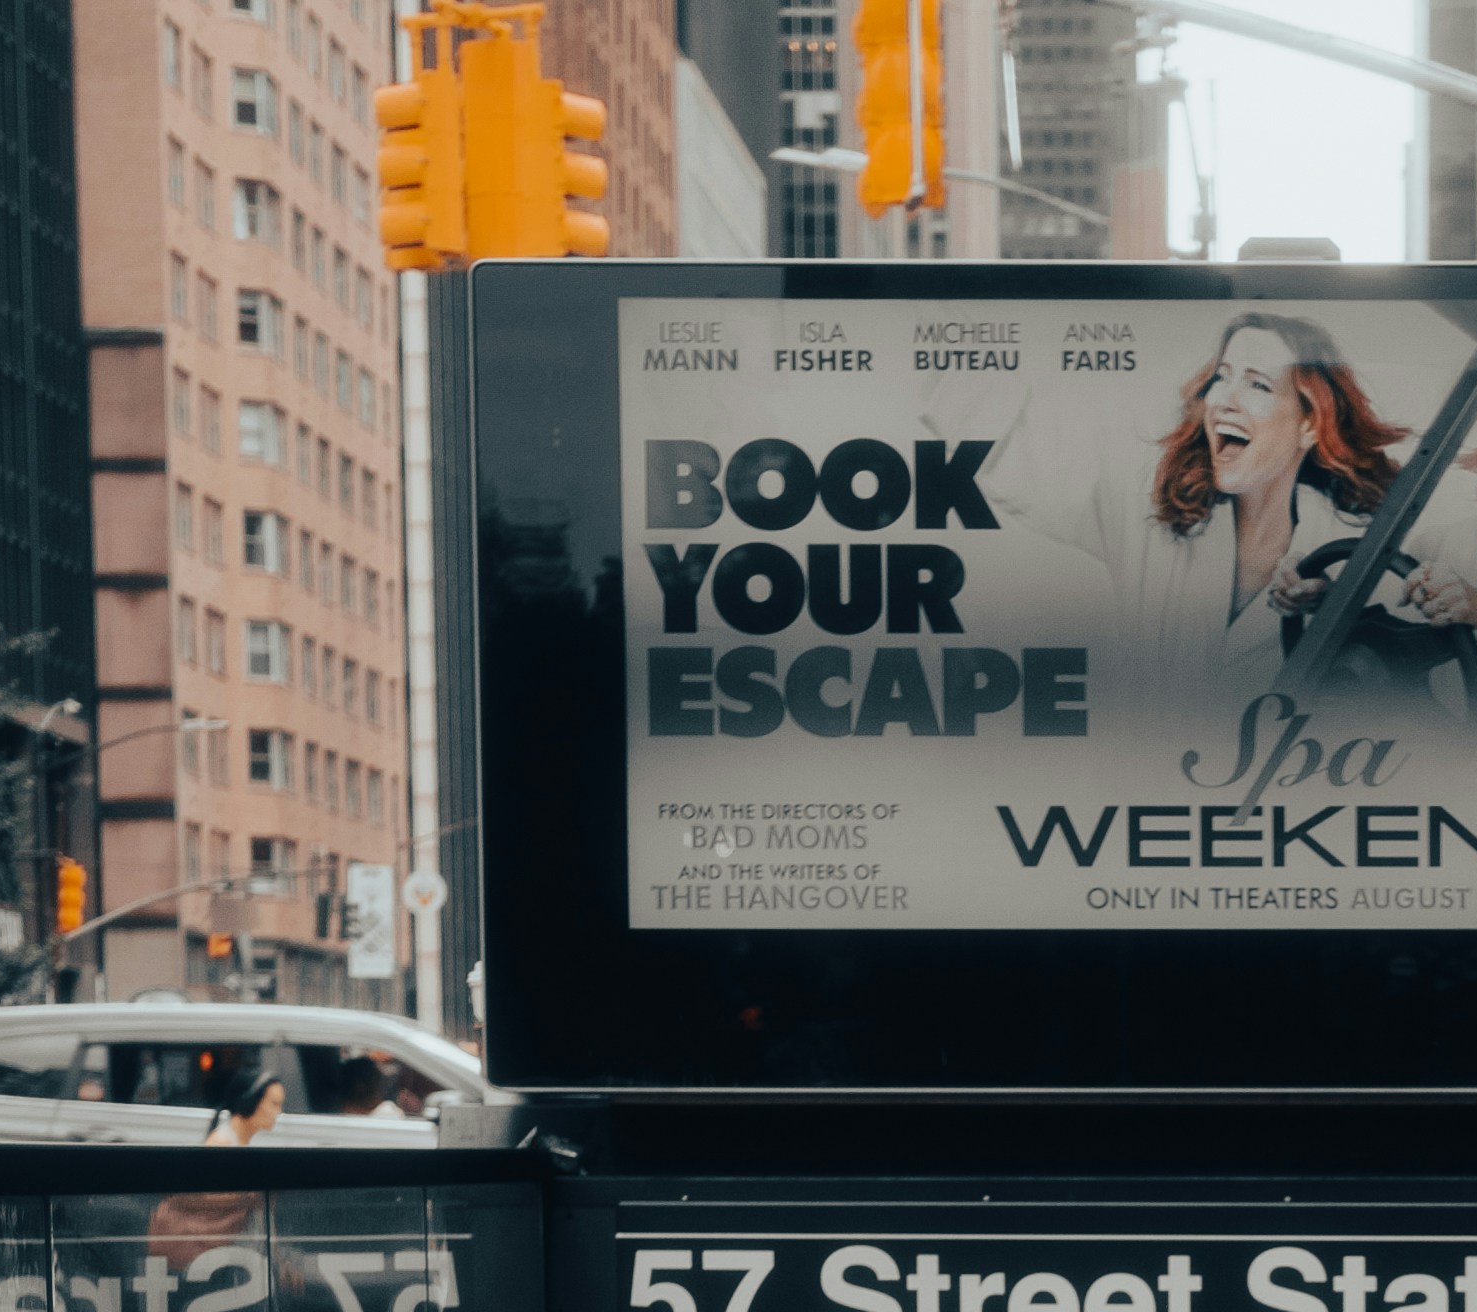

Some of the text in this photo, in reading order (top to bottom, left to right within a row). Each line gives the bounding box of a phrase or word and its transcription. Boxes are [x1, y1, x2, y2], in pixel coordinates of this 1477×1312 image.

[659, 321, 723, 344] LESLIE
[799, 321, 847, 344] ISLA
[913, 322, 1021, 345] MICHELLE
[1062, 322, 1137, 344] ANNA
[643, 348, 738, 372] MANN
[773, 349, 874, 372] FISHER
[913, 349, 1020, 372] BUTEAU
[1061, 349, 1138, 372] FARIS
[644, 437, 1002, 532] BOOK
[644, 543, 966, 635] YOUR
[645, 645, 1089, 738] ESCAPE
[1180, 693, 1412, 827] Spa
[657, 802, 902, 820] FROM THE DIRECTORS OF
[690, 824, 869, 850] BAD MOMS
[678, 863, 882, 880] AND THE WRITERS OF
[650, 885, 909, 910] THE HANGOVER
[1086, 886, 1162, 910] ONLY
[1170, 886, 1200, 910] IN
[1211, 886, 1339, 910] THEATERS
[1350, 886, 1473, 910] AUGUST
